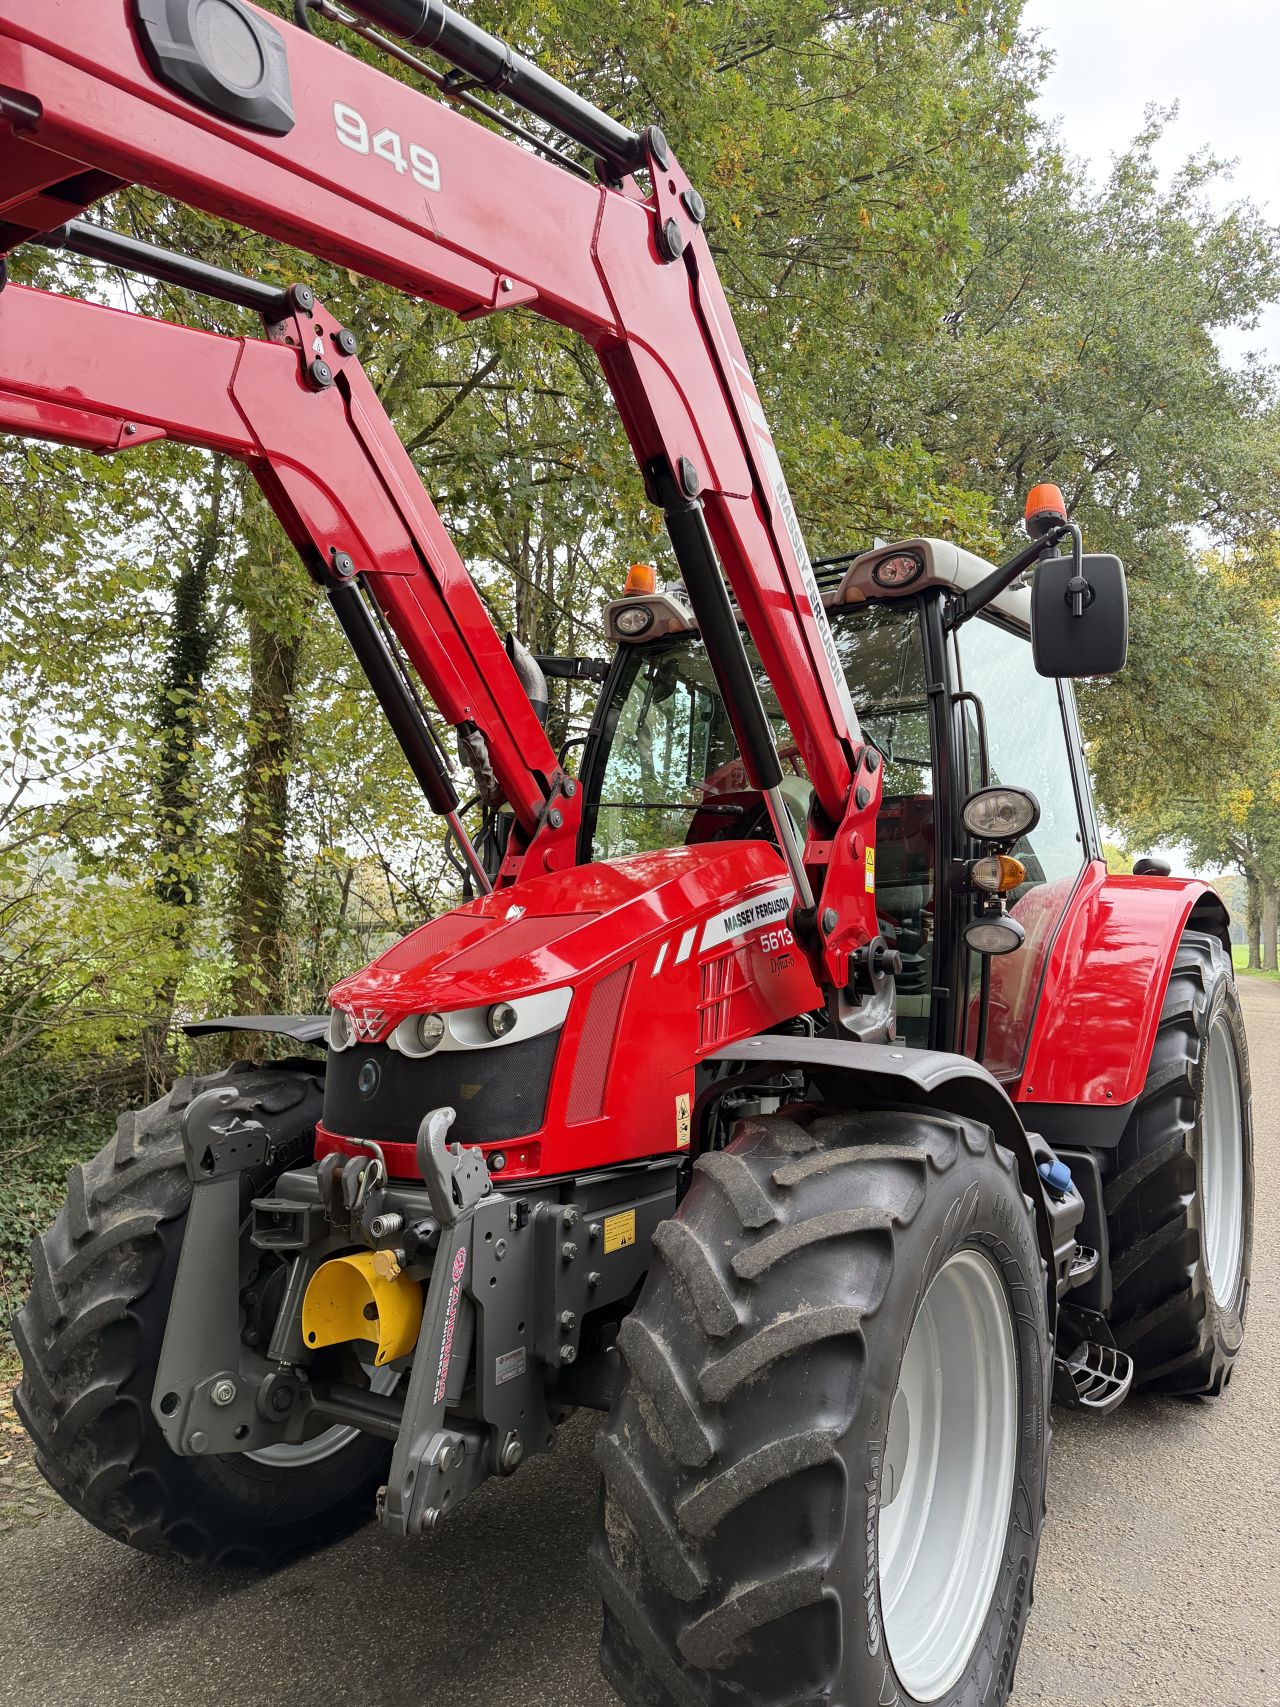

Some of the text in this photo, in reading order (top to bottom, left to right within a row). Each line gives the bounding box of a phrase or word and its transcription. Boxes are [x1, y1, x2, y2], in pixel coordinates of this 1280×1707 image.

[332, 99, 442, 193] 949
[776, 481, 843, 688] MASSEY FERGUSON
[724, 897, 790, 933] MASSEY FERGUSON
[760, 928, 793, 952] 5613
[437, 1282, 461, 1401] ZUIDBERG
